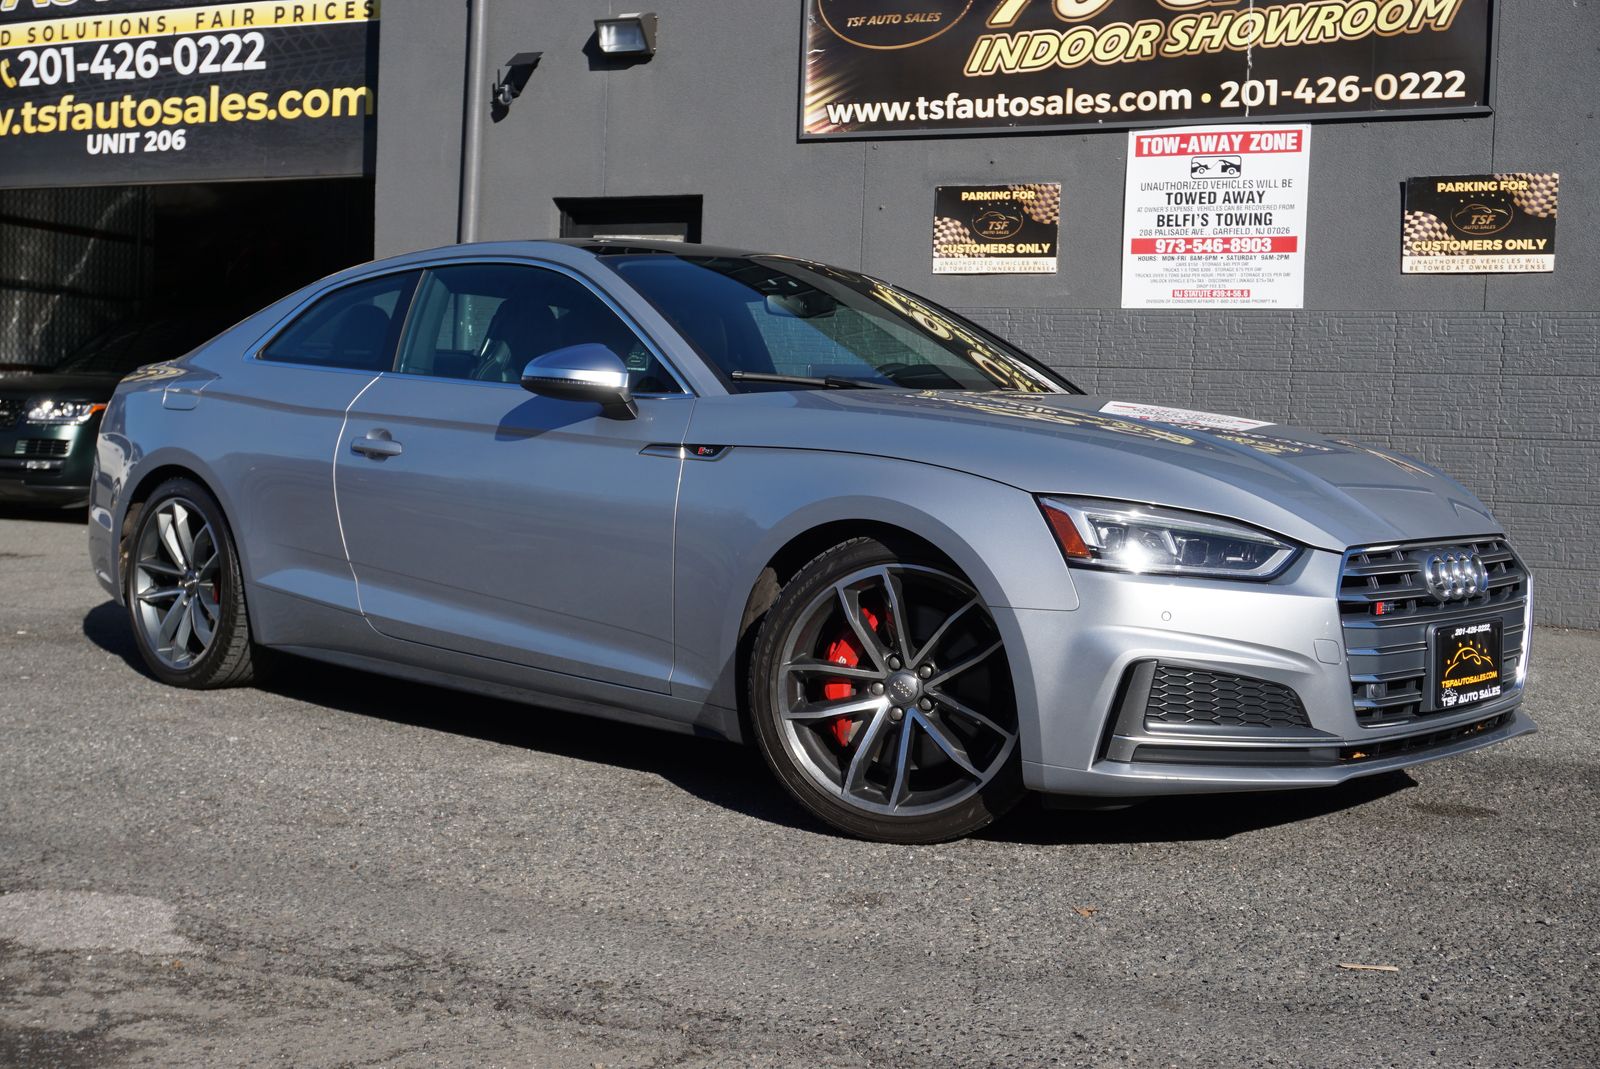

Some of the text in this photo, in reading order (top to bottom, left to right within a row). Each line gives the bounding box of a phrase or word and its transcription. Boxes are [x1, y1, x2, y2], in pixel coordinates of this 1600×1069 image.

[196, 8, 254, 37] FAIR
[275, 0, 374, 22] PRICES
[847, 12, 942, 27] TSF AUTO SALES
[965, 20, 1162, 76] INDOOR
[1163, 0, 1461, 55] SHOWROOM
[18, 32, 266, 87] 201-426-0222
[826, 69, 1466, 124] www.tsfautosales.com 201-426-0222
[87, 130, 186, 155] UNIT 206
[1140, 132, 1298, 154] TOW-AWAY ZONE
[1140, 178, 1293, 191] UNAUTHORIZED VEHICLES WILL BE
[1437, 180, 1528, 192] PARKING FOR
[961, 191, 1035, 200] PARKING FOR
[1165, 190, 1265, 205] TOWED AWAY
[988, 221, 1009, 230] TSF
[1157, 212, 1273, 227] BELFI'S TOWING
[1471, 215, 1496, 225] TSF
[1154, 228, 1189, 236] PALISADE
[1256, 227, 1265, 235] NJ
[940, 243, 1051, 254] CUSTOMERS ONLY
[1155, 238, 1272, 253] 973-546-8903
[1412, 239, 1547, 251] CUSTOMERS ONLY
[1441, 670, 1498, 688] TSFAUTOSALES.COM
[1442, 685, 1501, 707] TSF AUTO SALES
